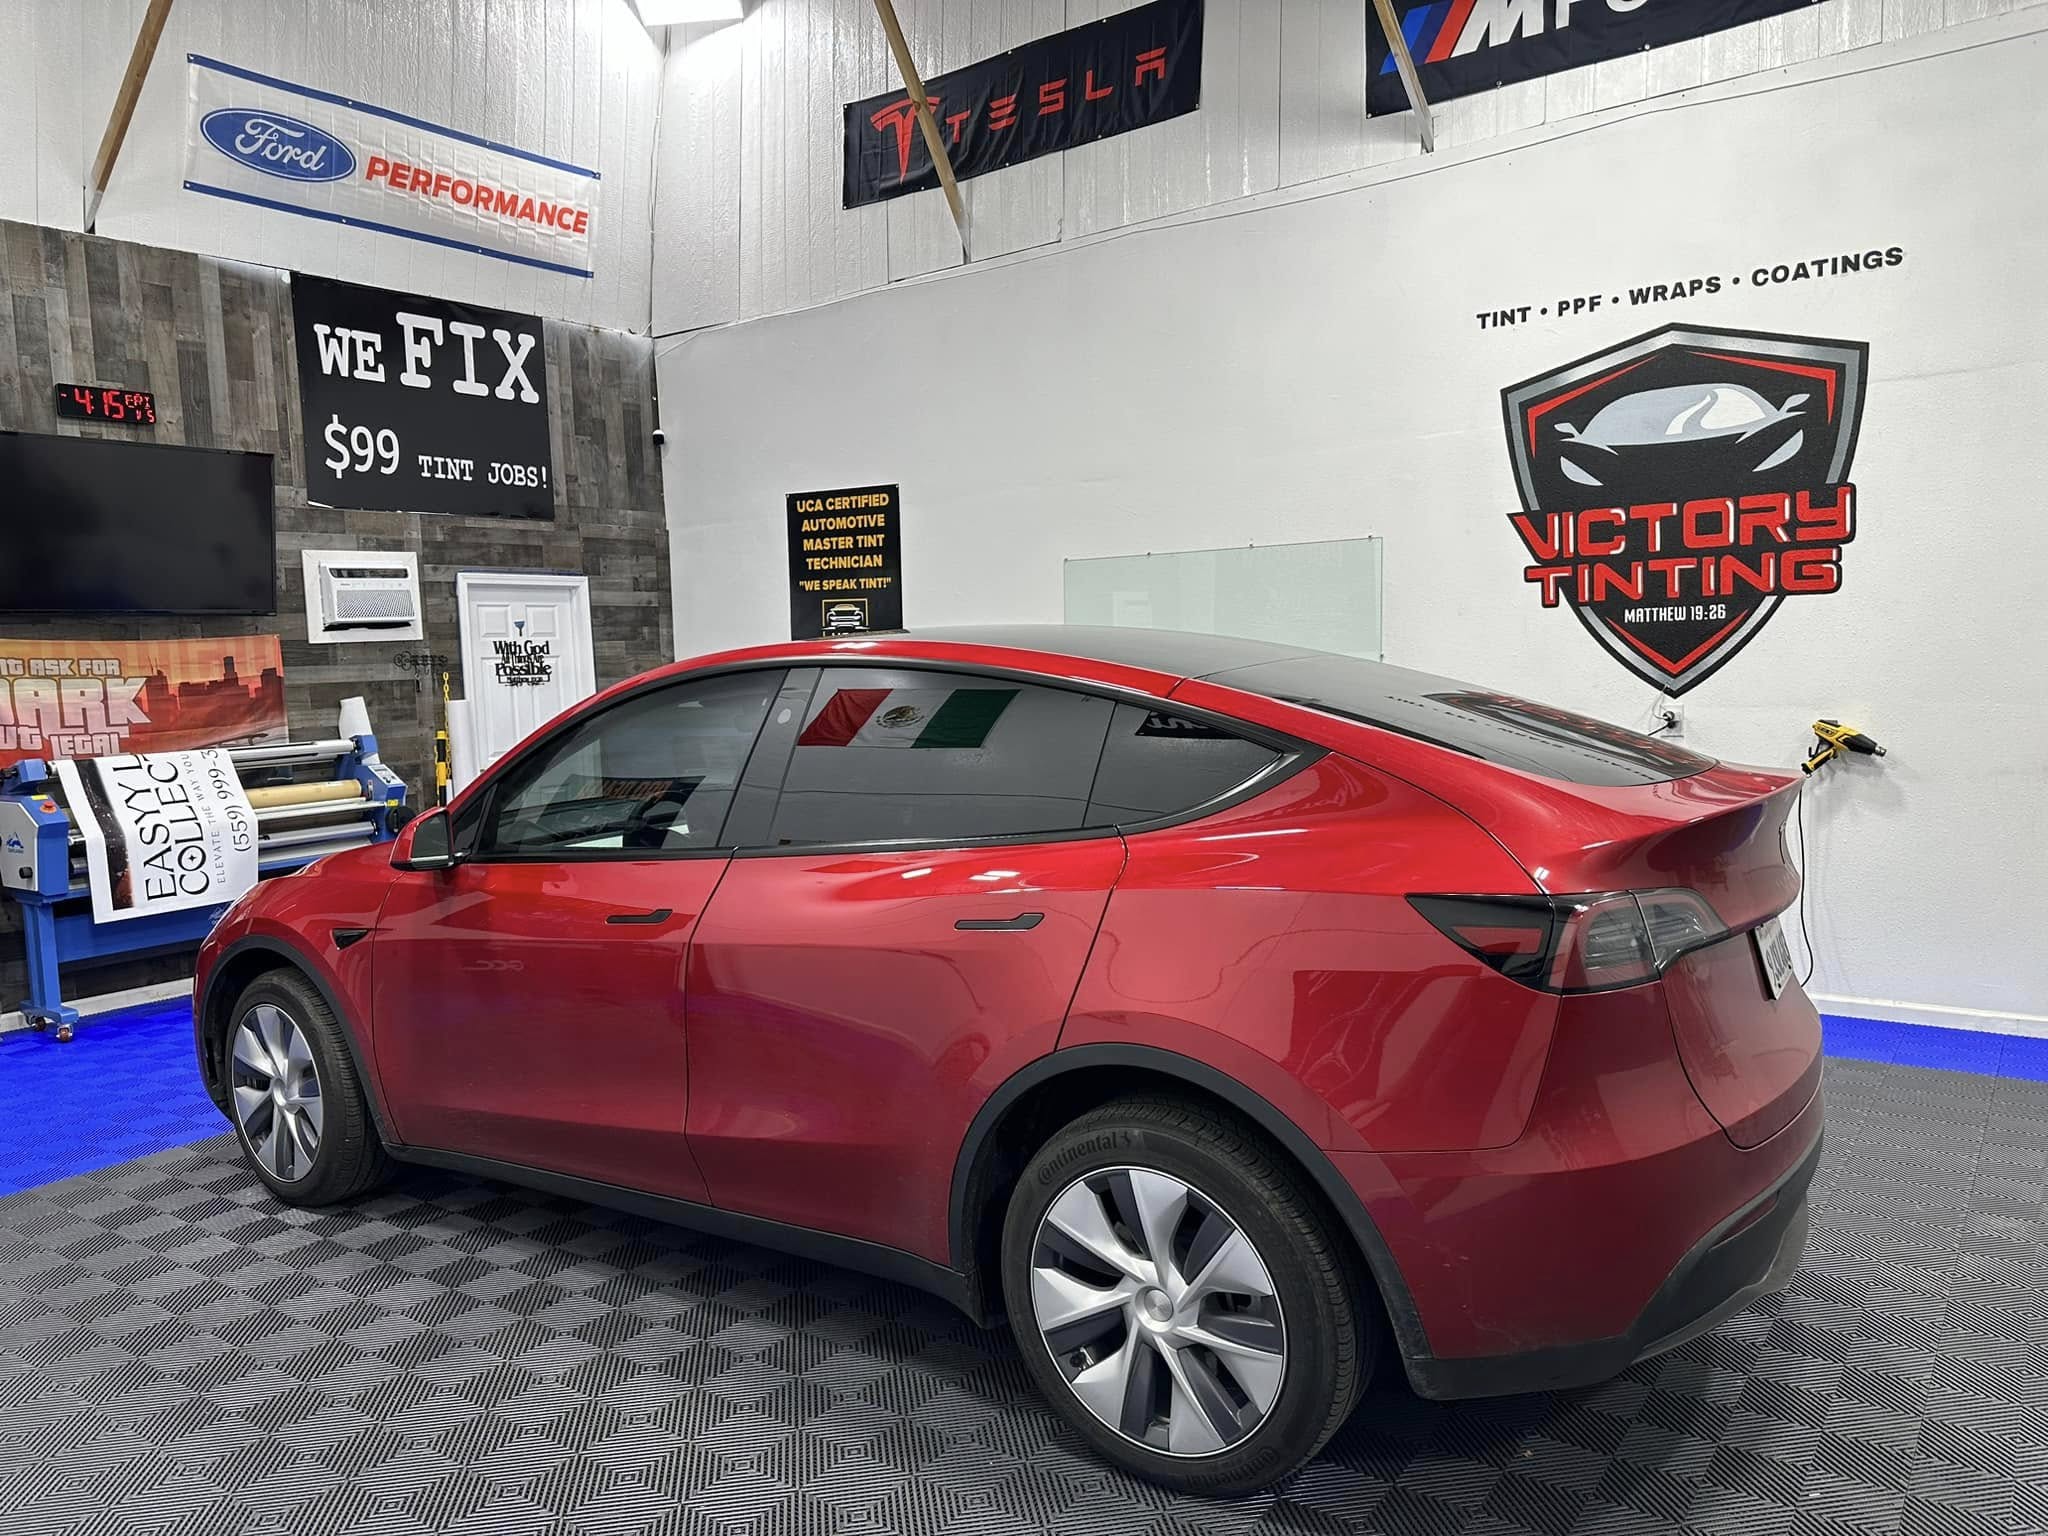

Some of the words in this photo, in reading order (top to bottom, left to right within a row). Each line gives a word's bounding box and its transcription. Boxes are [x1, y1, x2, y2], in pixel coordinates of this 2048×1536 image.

[946, 46, 1167, 144] TESLA
[235, 118, 327, 171] Ford
[365, 156, 588, 234] PERFORMANCE
[1476, 305, 1531, 329] TINT
[1558, 295, 1602, 317] PPF
[1628, 276, 1721, 306] WRAPS
[1751, 246, 1904, 287] COATINGS
[313, 323, 386, 383] WE
[396, 311, 540, 404] FIX
[324, 414, 400, 479] $99
[418, 455, 474, 481] TINT
[488, 462, 548, 488] JOBS!
[796, 499, 824, 513] UCA
[825, 493, 889, 511] CERTIFIED
[801, 513, 886, 532] AUTOMOTIVE
[1513, 486, 1851, 560] VICTORY
[803, 536, 854, 551] MASTER
[856, 534, 885, 548] TINT
[806, 554, 883, 570] TECHNICIAN
[1525, 547, 1837, 605] TINTING
[799, 580, 821, 591] "WE
[822, 579, 857, 590] SPEAK
[859, 576, 891, 589] TINT!"
[1624, 605, 1687, 624] MATTHEW
[1690, 603, 1726, 621] 19:26
[493, 640, 522, 655] With
[524, 640, 550, 655] God
[30, 658, 76, 676] ASK
[78, 658, 122, 676] FOR
[495, 662, 553, 676] Possible
[50, 732, 130, 760] LEGAL
[189, 780, 204, 802] WAY
[200, 749, 234, 800] 999-3
[141, 753, 210, 895] COLLEC
[203, 806, 217, 825] THE
[224, 804, 252, 852] (559)
[210, 831, 226, 884] ELEVATE
